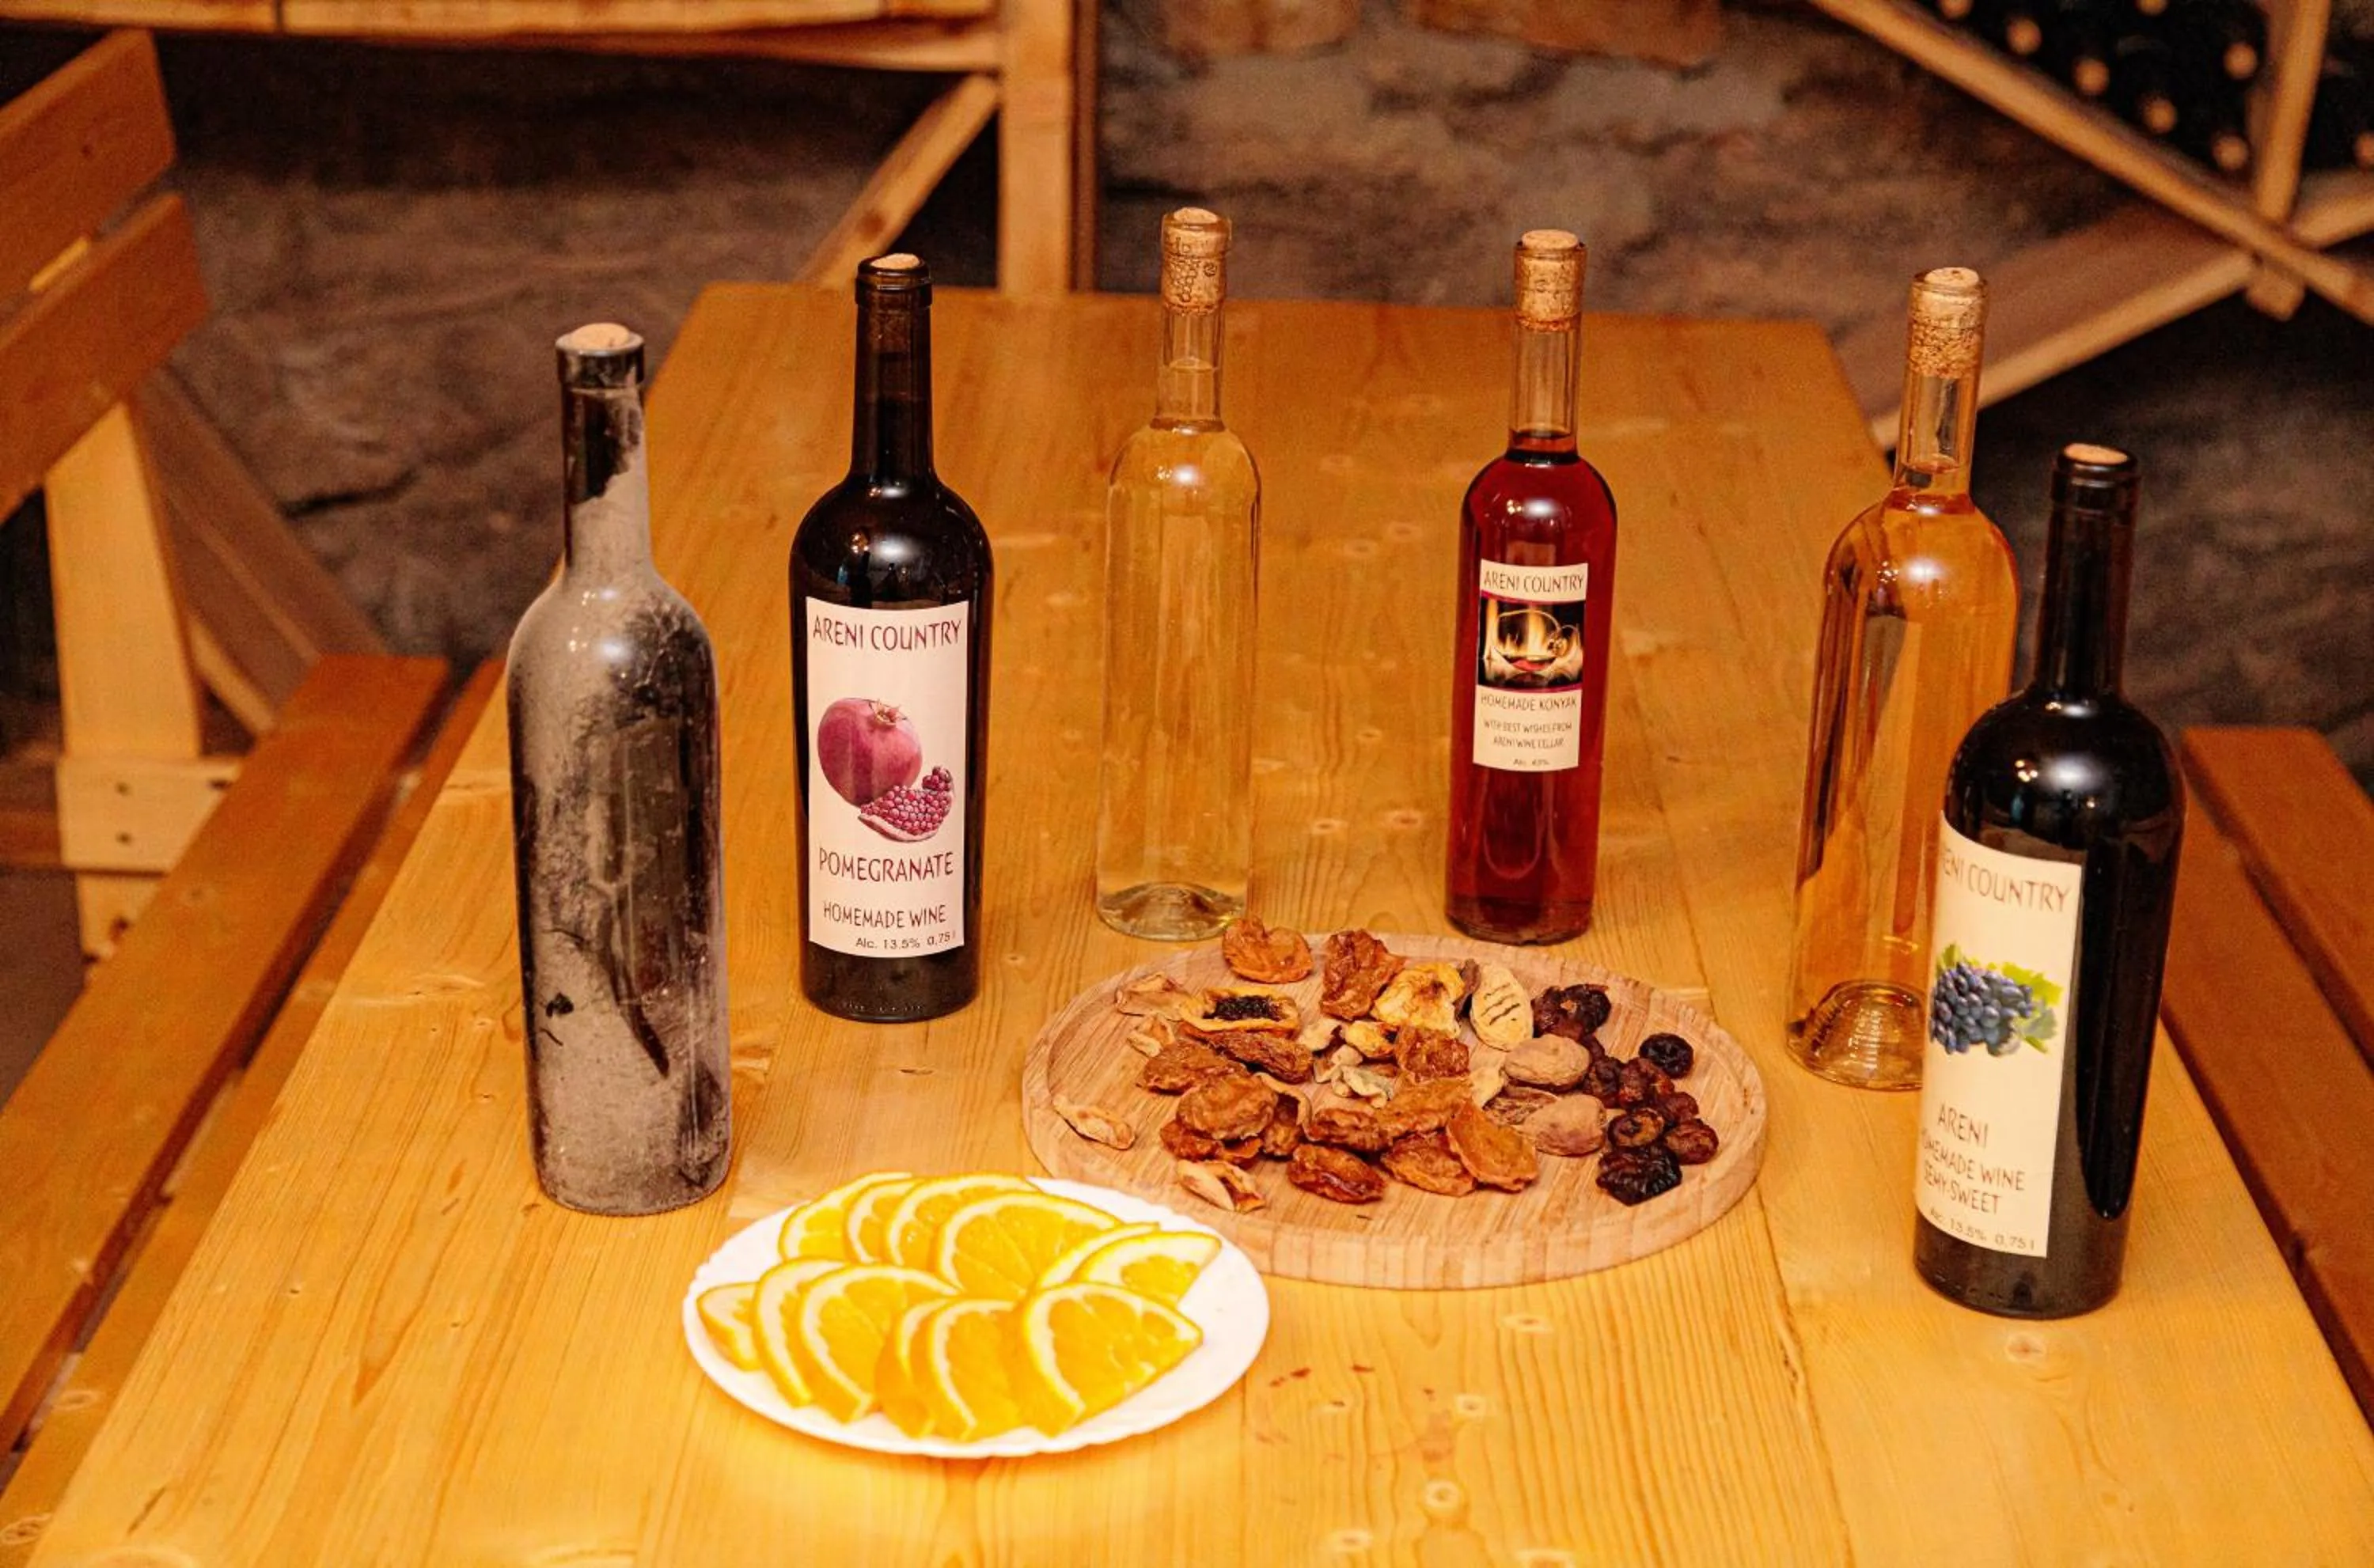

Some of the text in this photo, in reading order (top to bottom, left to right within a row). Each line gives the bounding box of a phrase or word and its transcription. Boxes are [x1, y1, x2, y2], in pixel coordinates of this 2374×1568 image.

[1484, 571, 1583, 593] ARENI COUNTRY
[813, 615, 962, 651] ARENI COUNTRY
[1481, 694, 1537, 711] HOMEMADE
[819, 847, 954, 883] POMEGRANATE
[1967, 862, 2071, 913] COUNTRY
[823, 900, 947, 929] HOMEMADE WINE
[855, 937, 878, 949] Alc.
[1938, 1103, 1989, 1149] ARENI
[1980, 1162, 2026, 1191] WINE
